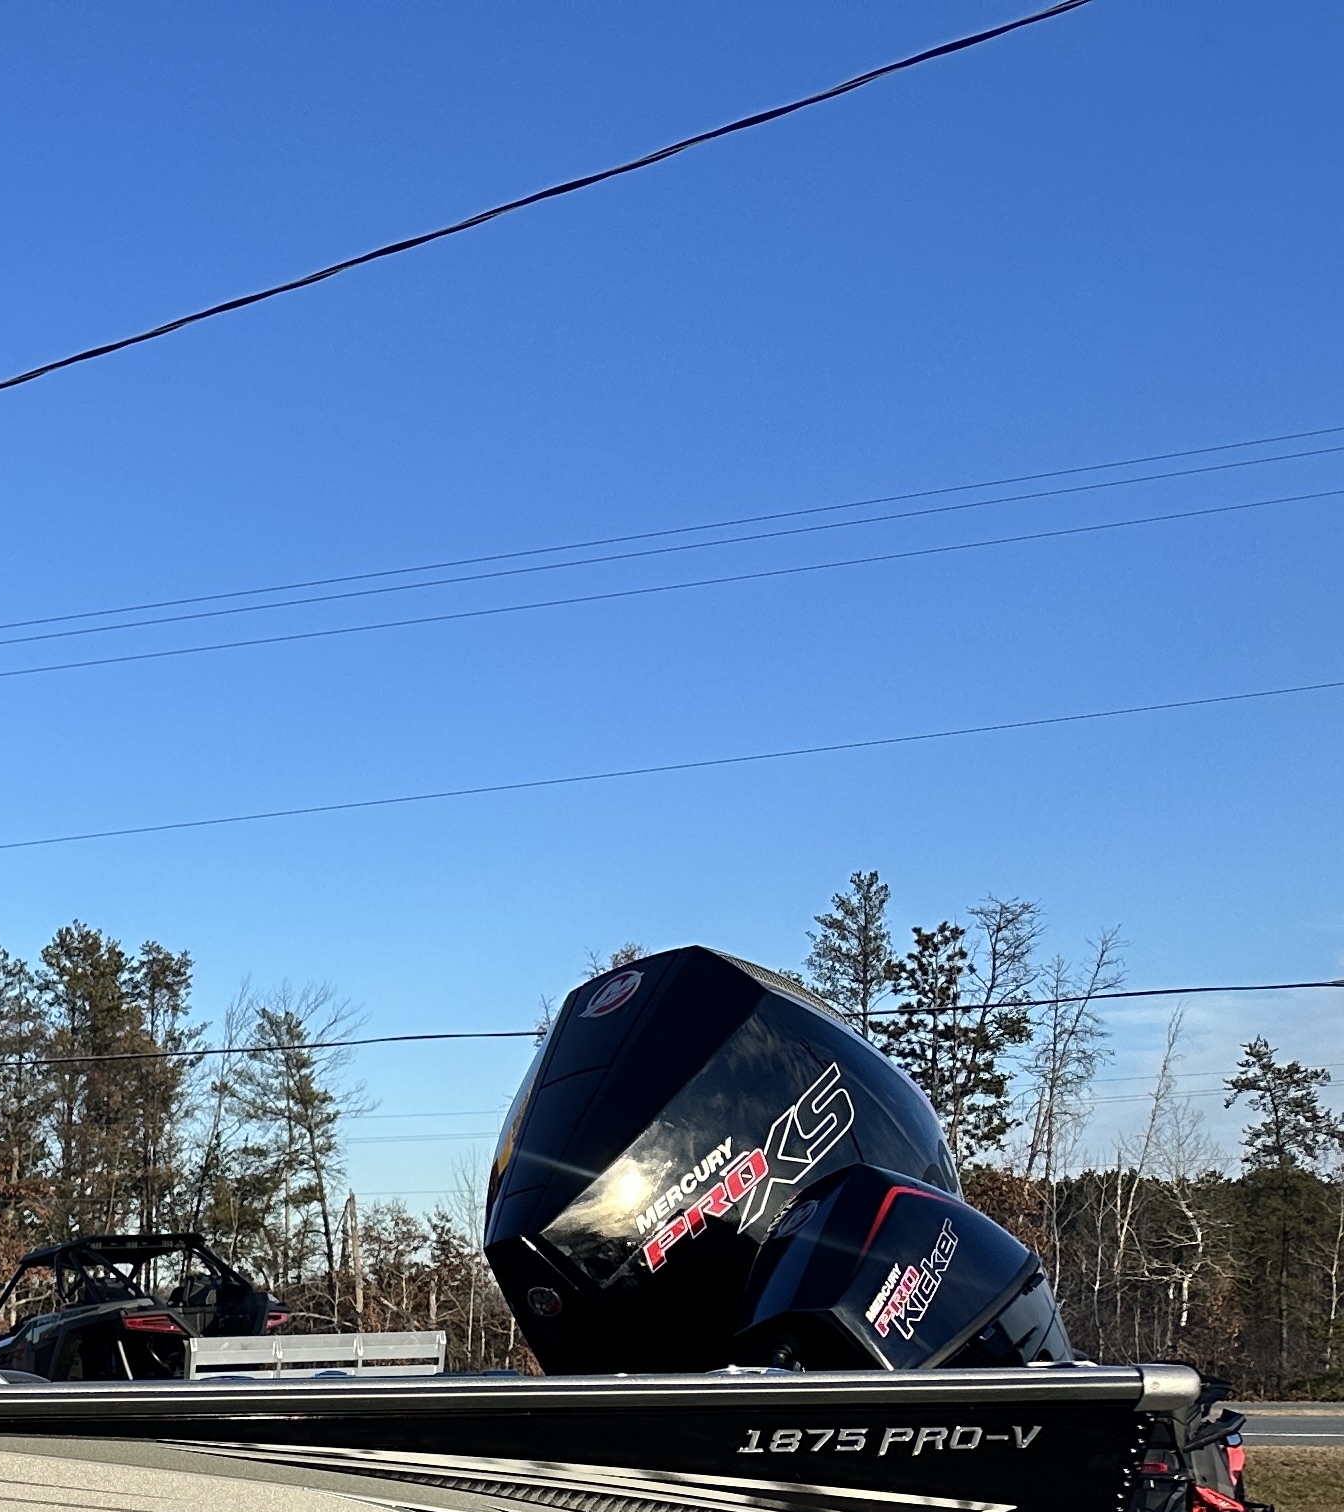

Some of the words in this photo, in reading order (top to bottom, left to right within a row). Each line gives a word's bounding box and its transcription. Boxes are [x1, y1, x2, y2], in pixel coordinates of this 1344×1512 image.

[635, 1136, 734, 1235] MERCURY
[643, 1147, 769, 1274] PRO
[736, 1061, 855, 1234] XS
[865, 1262, 902, 1323] MERCURY
[874, 1265, 920, 1338] PRO
[737, 1428, 869, 1453] 1875
[877, 1425, 1043, 1457] PRO-V
